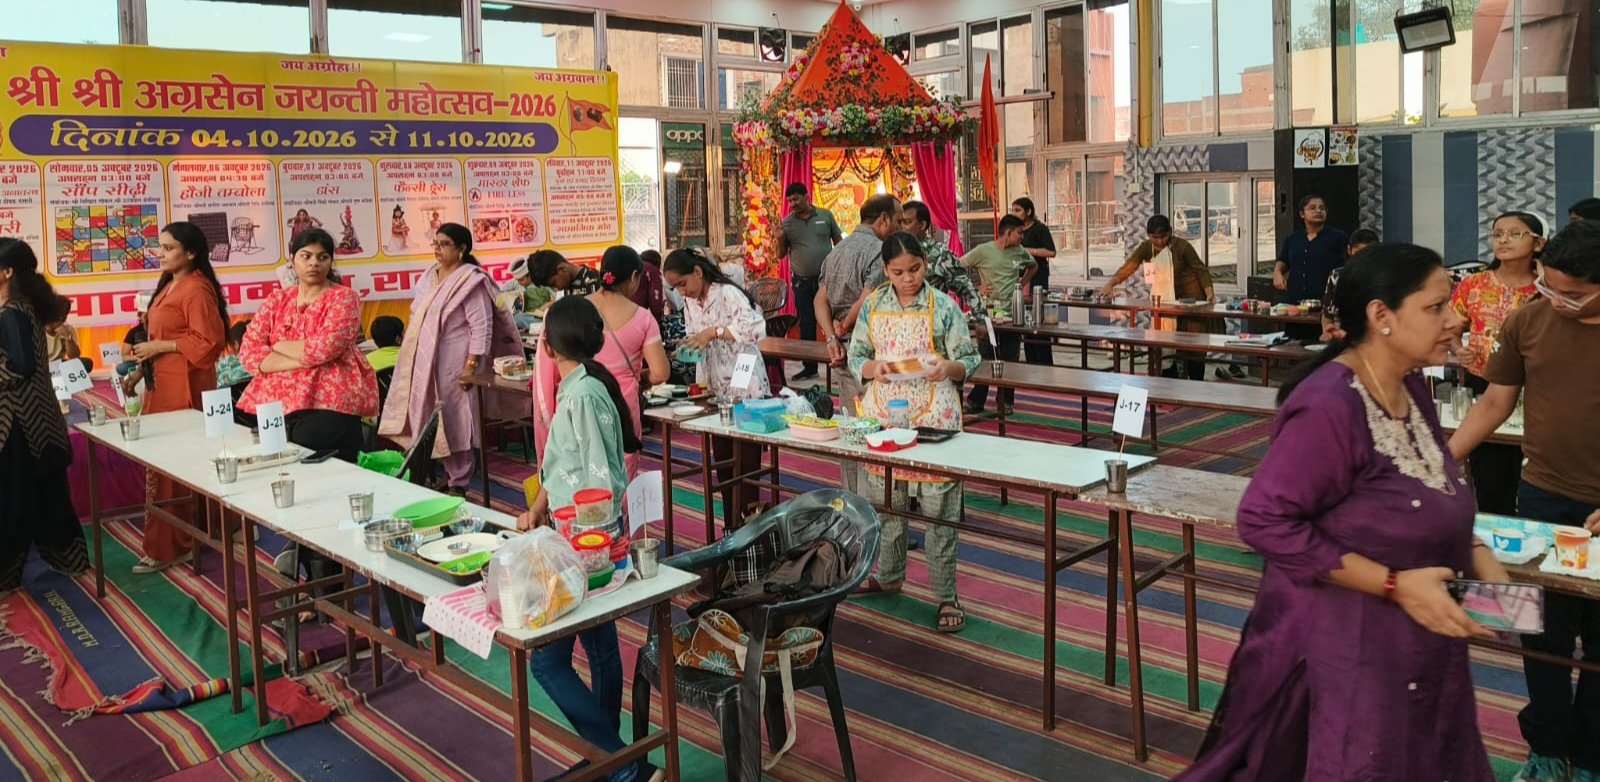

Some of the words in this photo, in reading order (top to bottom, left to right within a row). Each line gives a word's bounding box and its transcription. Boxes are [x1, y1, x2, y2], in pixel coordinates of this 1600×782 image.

[7, 66, 60, 107] श्री
[72, 68, 123, 110] श्री
[134, 74, 266, 113] अग्रसेन
[273, 78, 378, 115] जयन्ती
[51, 119, 184, 152] दिनांक
[191, 129, 356, 149] 04.10.2026
[368, 123, 400, 148] से
[408, 130, 535, 149] 11.10.2026
[135, 164, 158, 172] 2026
[68, 370, 87, 382] S-6
[206, 403, 231, 417] J-24
[1120, 399, 1141, 412] J-17
